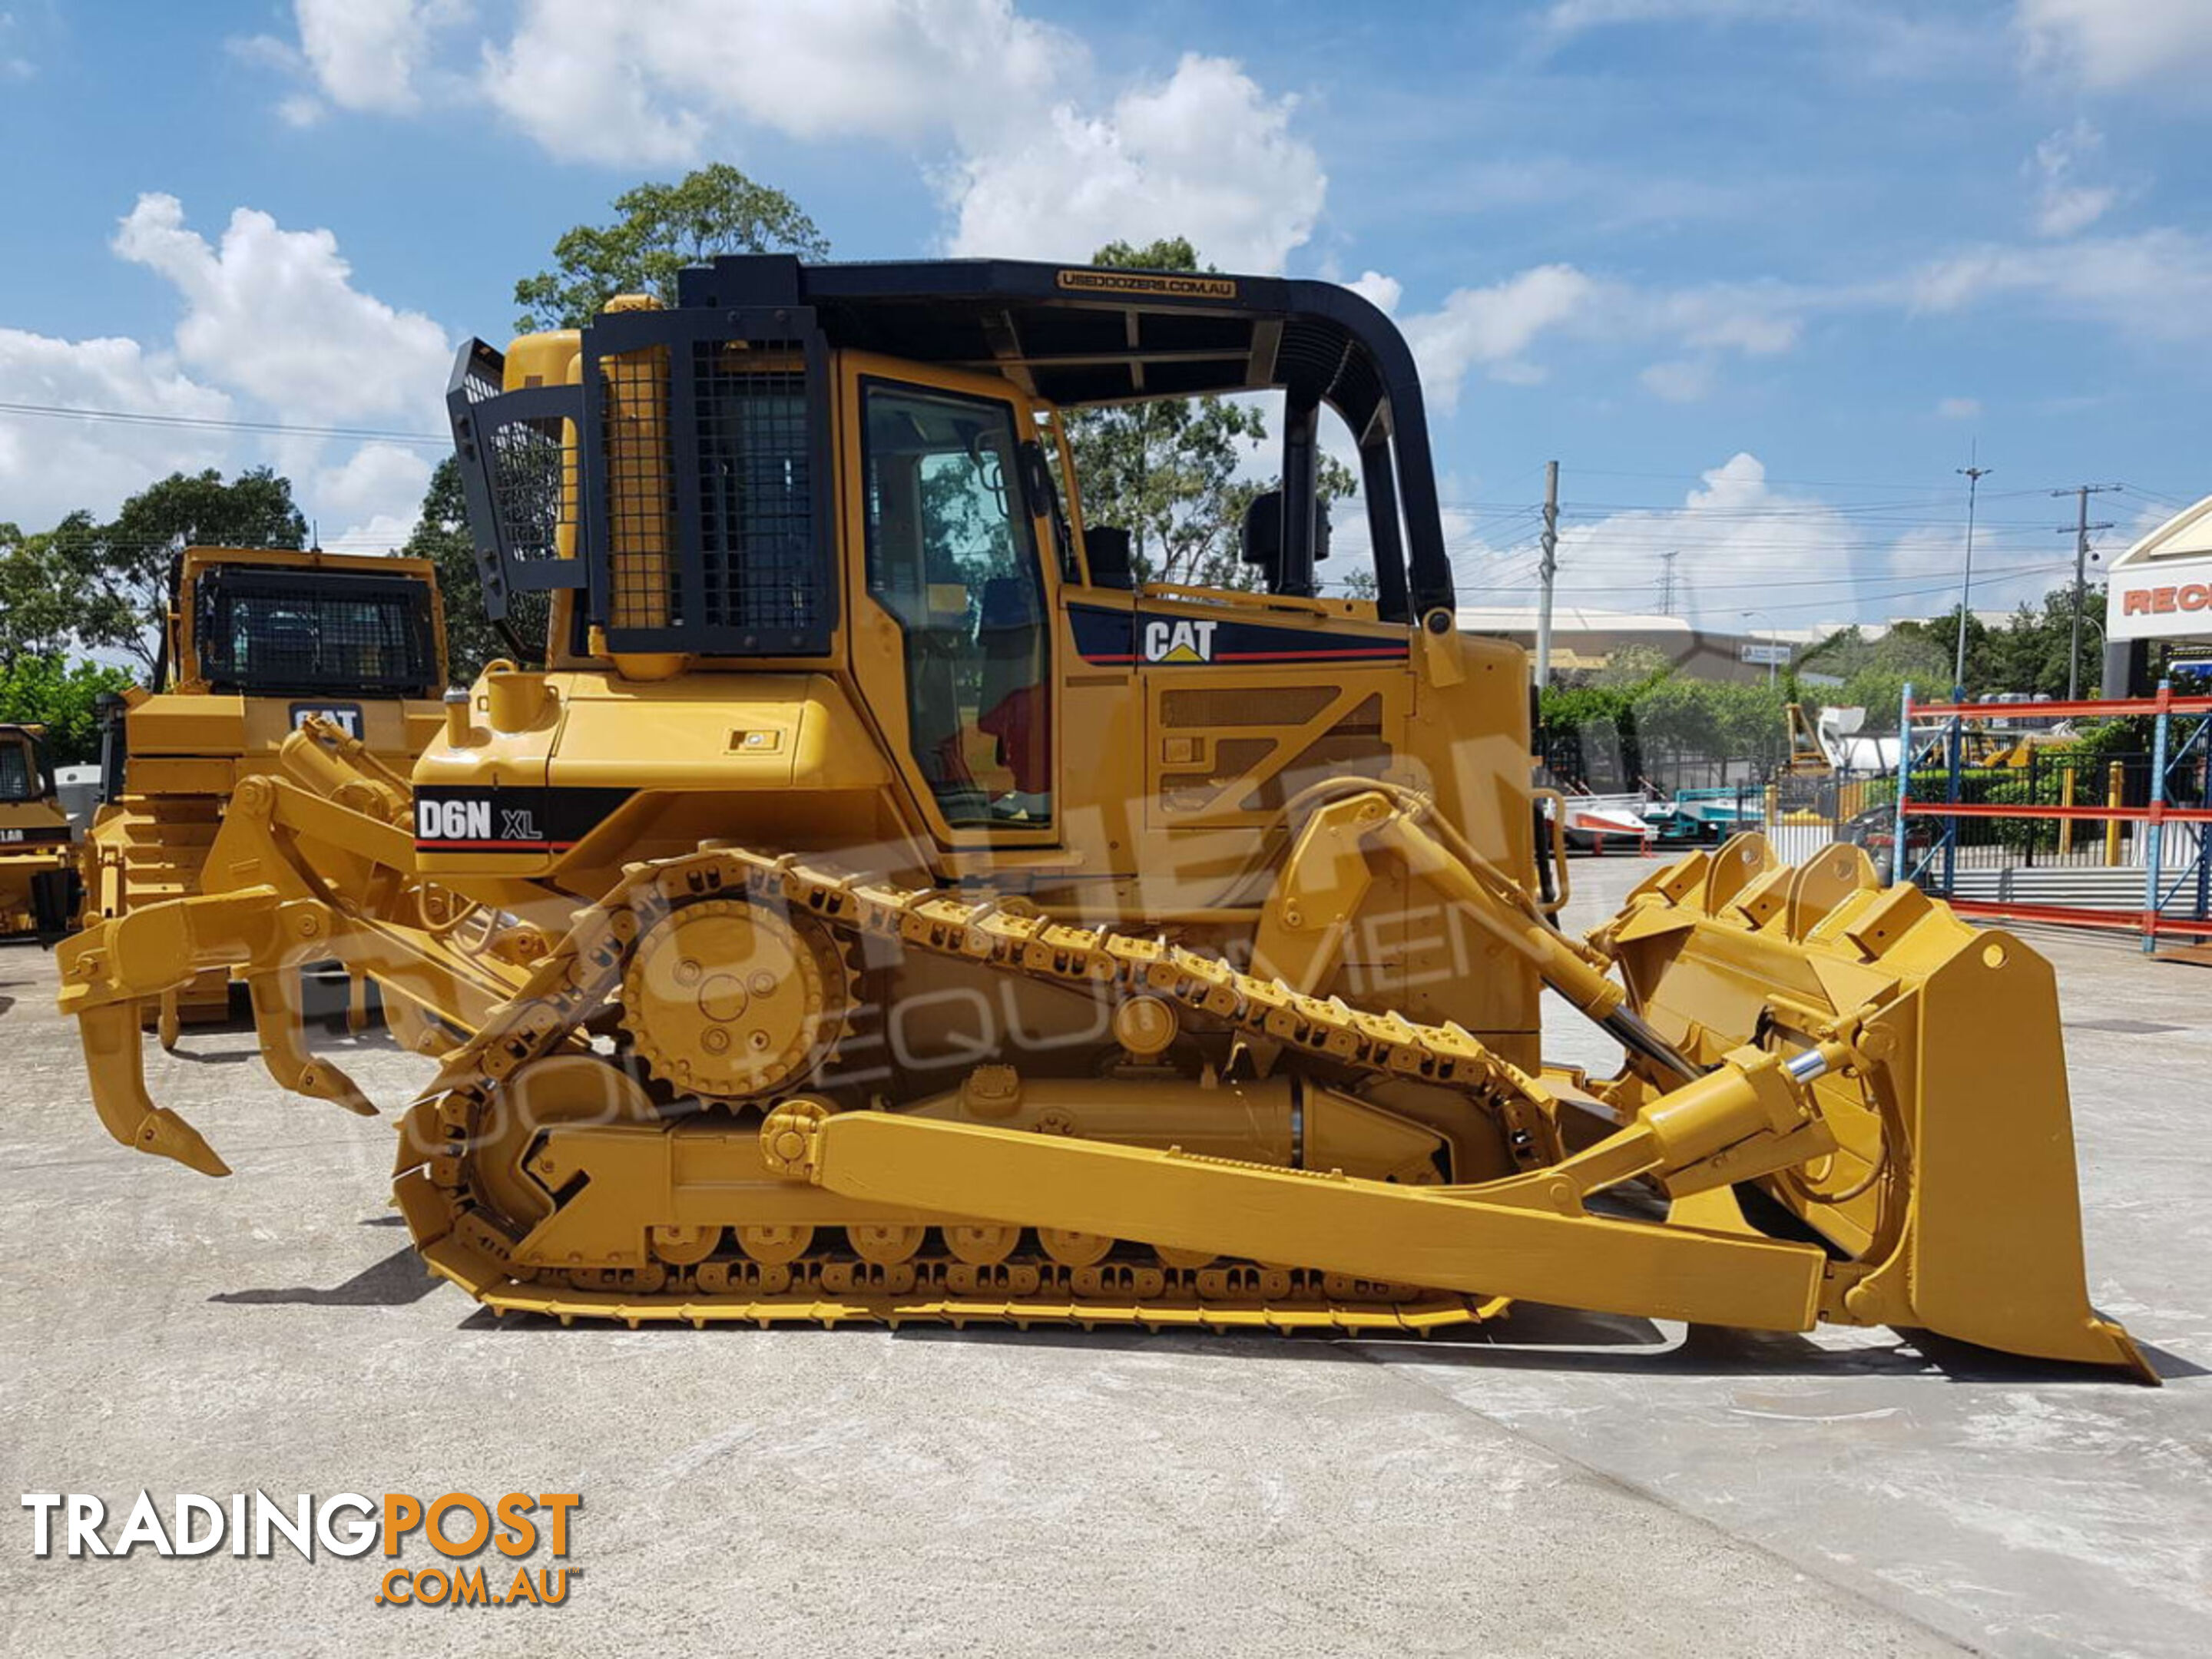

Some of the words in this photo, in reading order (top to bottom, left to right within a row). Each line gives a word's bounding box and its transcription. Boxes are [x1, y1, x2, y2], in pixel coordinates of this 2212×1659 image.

[2123, 584, 2212, 616] REC
[1145, 621, 1217, 662] CAT
[0, 829, 24, 842] LAR
[419, 800, 492, 839] D6N
[501, 810, 543, 839] XL
